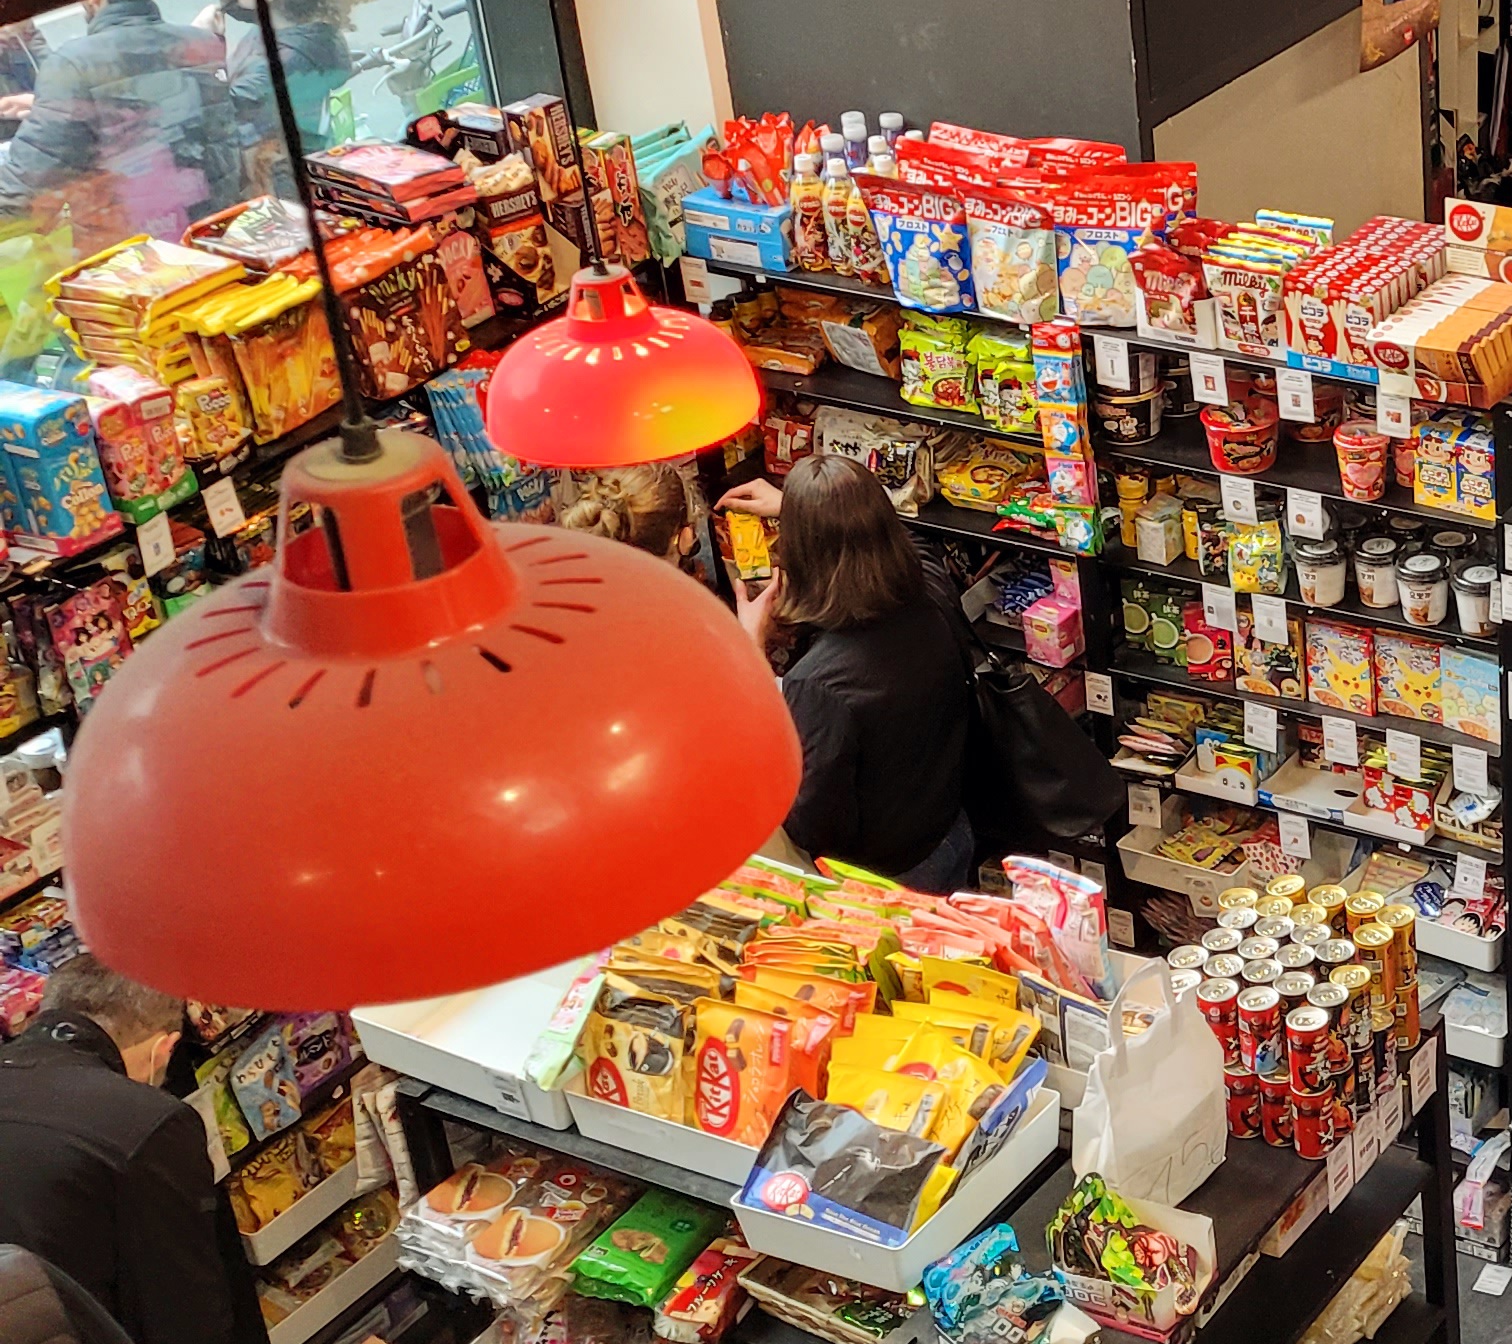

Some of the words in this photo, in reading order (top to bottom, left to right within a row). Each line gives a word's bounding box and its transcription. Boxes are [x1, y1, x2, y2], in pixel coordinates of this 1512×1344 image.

[490, 191, 538, 218] HERSHEY'S
[1221, 270, 1269, 297] Milky
[699, 1047, 731, 1129] KitKat
